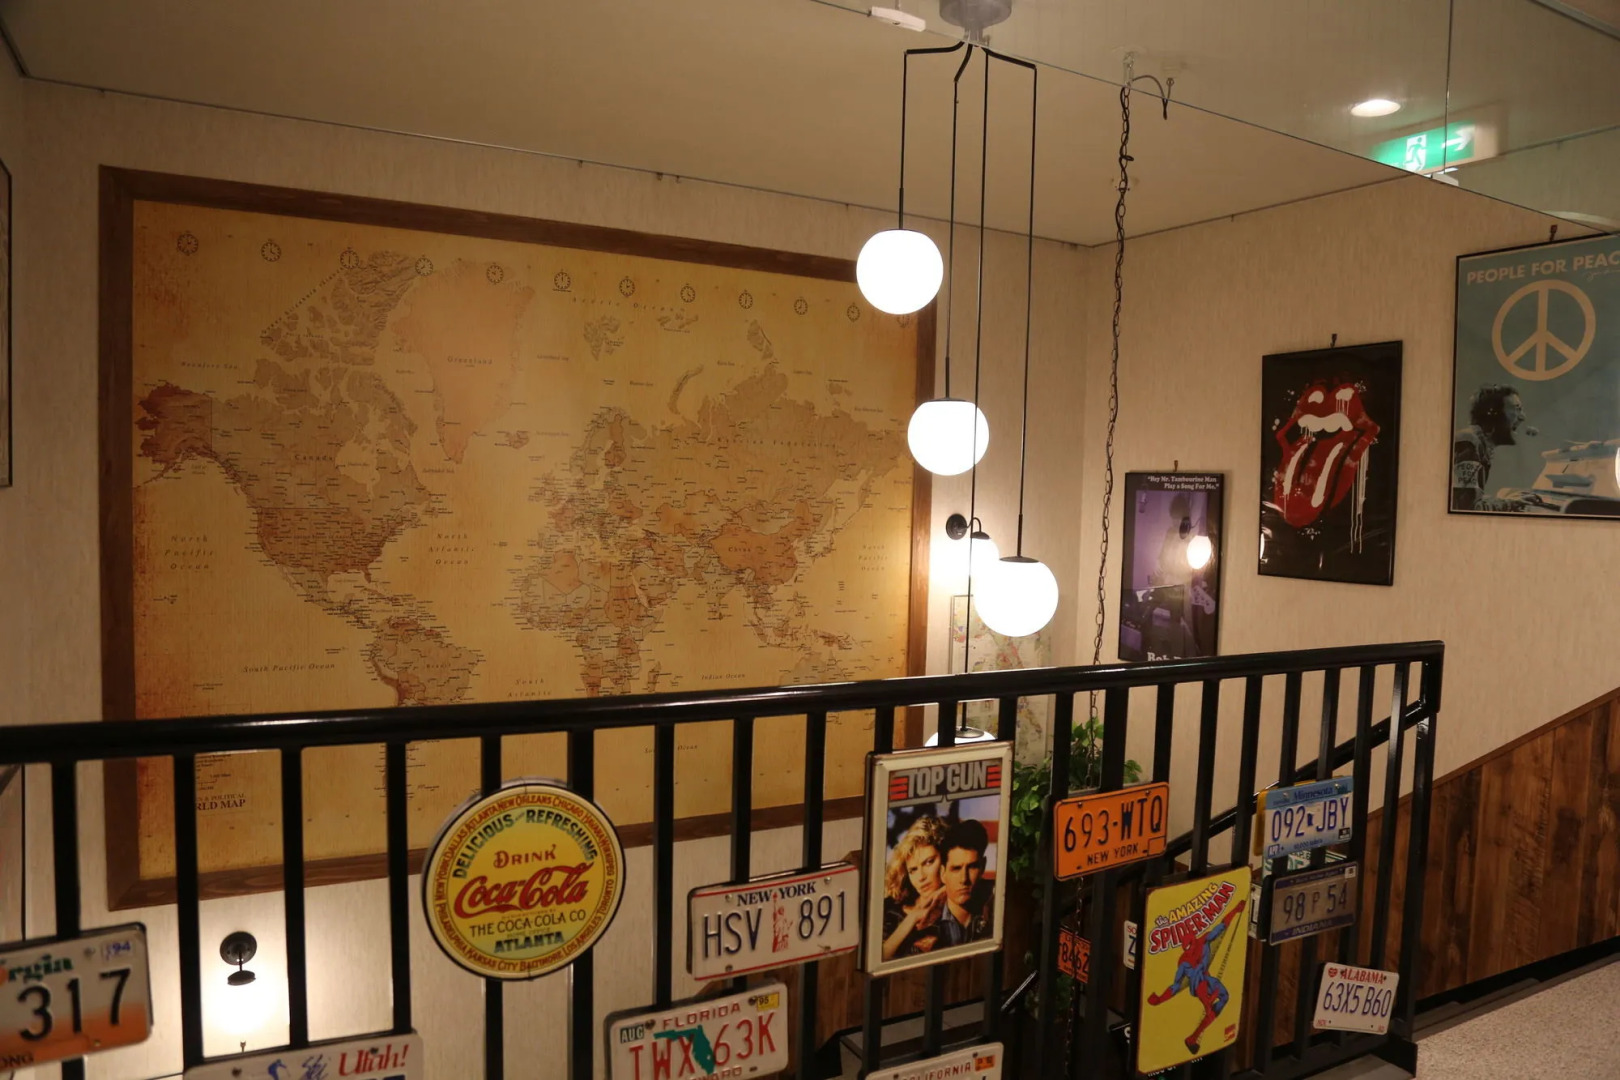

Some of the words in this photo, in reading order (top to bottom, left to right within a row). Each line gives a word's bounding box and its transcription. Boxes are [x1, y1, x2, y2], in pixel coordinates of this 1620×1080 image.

[1466, 265, 1525, 285] PEOPLE
[1531, 259, 1567, 276] FOR
[908, 765, 944, 798] TOP
[946, 760, 988, 795] GUN
[516, 794, 552, 807] ORLEANS
[1294, 785, 1334, 801] Minnesota
[196, 801, 218, 811] RLD
[220, 799, 247, 810] MAP
[552, 796, 584, 818] CHICAGO
[465, 804, 498, 833] ATLANTA
[452, 813, 515, 880] DELICIOUS
[525, 809, 599, 862] REFRESHING
[1087, 850, 1109, 866] NEW
[1112, 843, 1139, 861] YORK
[454, 861, 594, 919] Coca-Cola
[736, 889, 774, 907] NEW
[778, 880, 817, 900] YORK
[1156, 915, 1170, 927] the
[1168, 882, 1219, 923] AMAZING
[469, 923, 495, 938] THE
[703, 908, 763, 959] HSV
[799, 890, 846, 940] 891
[1291, 919, 1334, 936] INDIANA
[494, 931, 565, 954] ATLANTA
[497, 960, 519, 972] CITY
[1341, 968, 1384, 985] ALABAMA
[17, 967, 132, 1042] 317
[662, 1002, 741, 1031] FLORIDA
[620, 1026, 645, 1044] AUG
